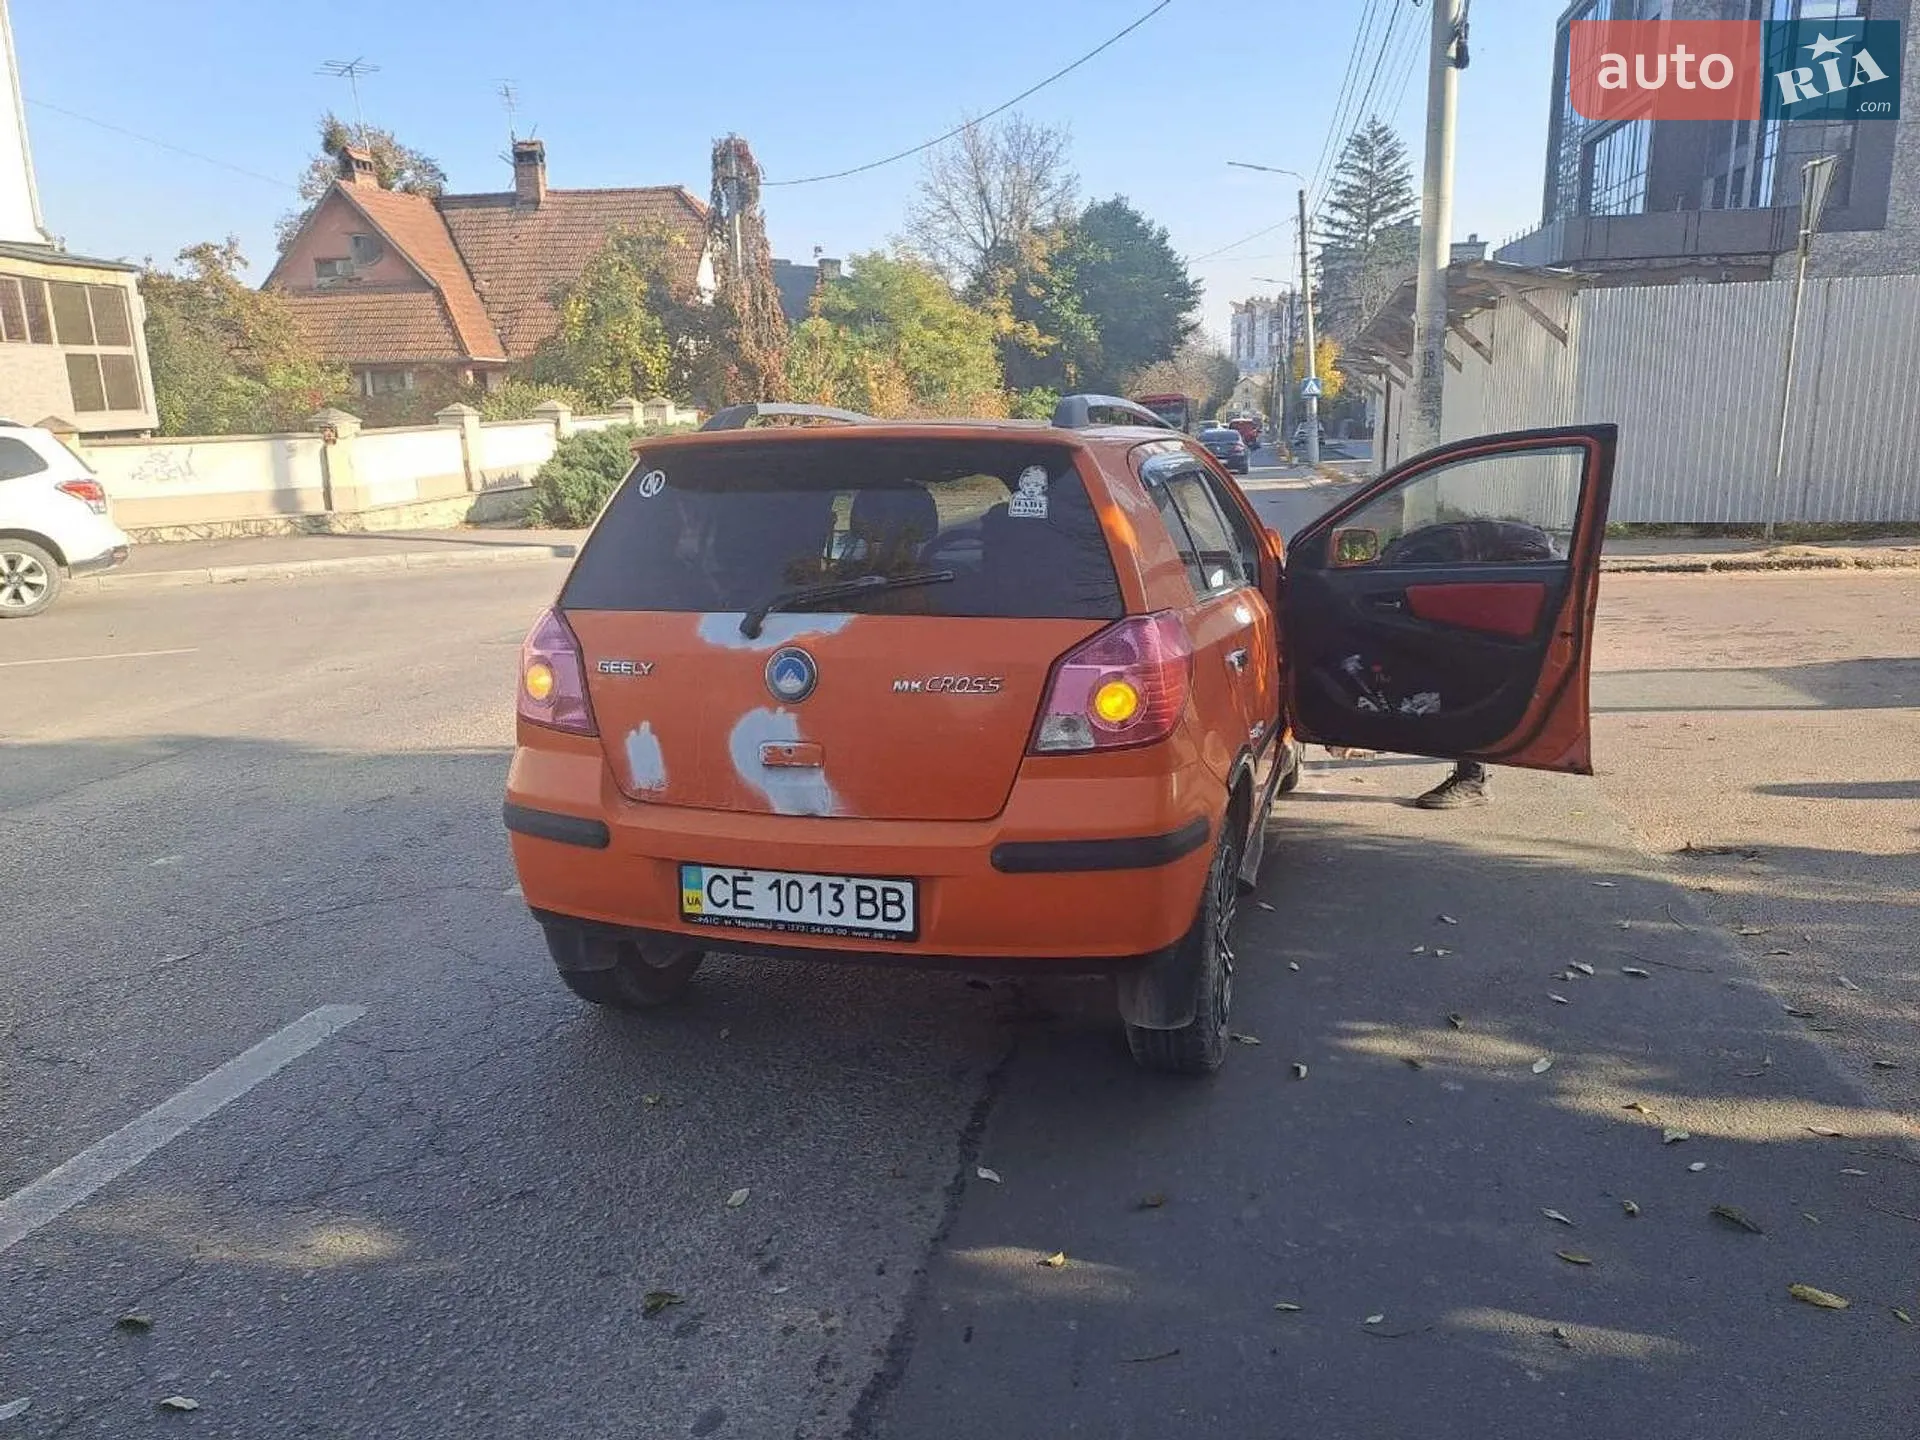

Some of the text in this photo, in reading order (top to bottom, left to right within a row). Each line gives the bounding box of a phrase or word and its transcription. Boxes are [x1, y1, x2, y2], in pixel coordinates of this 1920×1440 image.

[597, 660, 653, 675] GEELY
[892, 675, 1005, 694] MK CROSS
[686, 895, 702, 906] UA
[706, 874, 907, 922] CE 1013 BB
